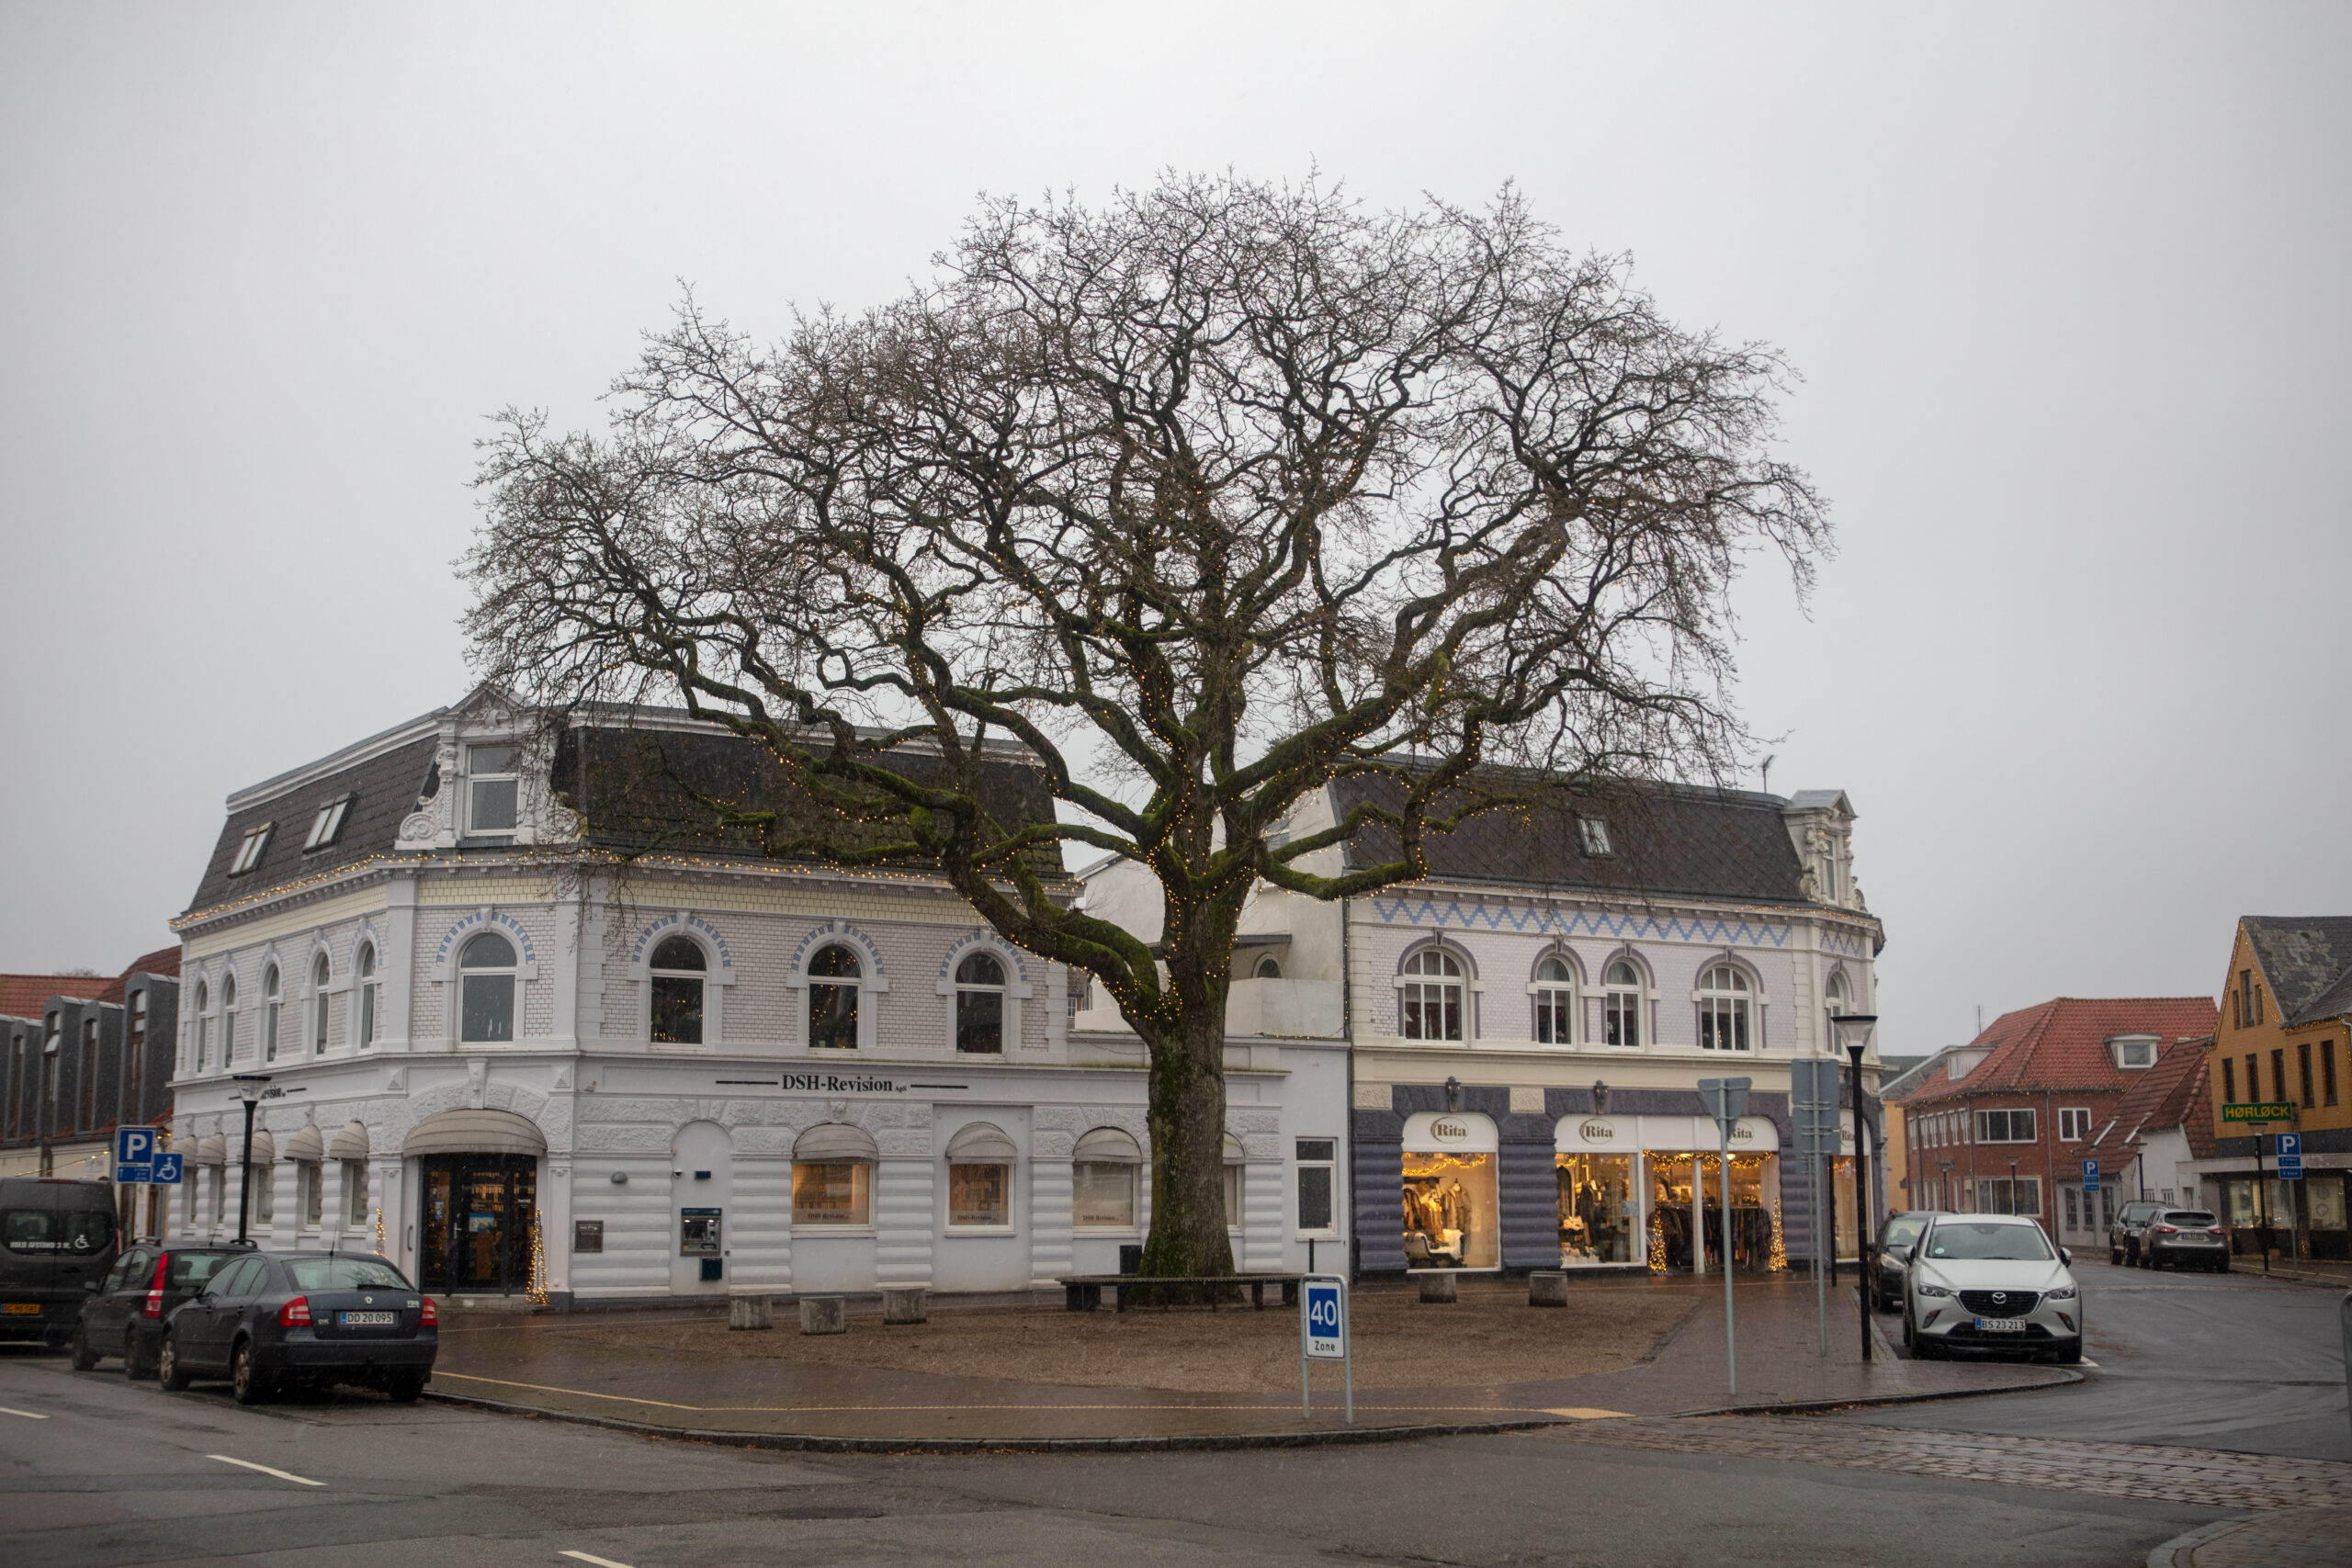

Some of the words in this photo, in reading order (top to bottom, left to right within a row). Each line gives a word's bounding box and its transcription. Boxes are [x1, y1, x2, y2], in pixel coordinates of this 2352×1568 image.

[782, 1074, 892, 1092] DSH-Revision
[2224, 1105, 2290, 1118] HØRLØCK
[1437, 1123, 1467, 1137] Rita
[1585, 1125, 1613, 1138] Rita
[127, 1134, 147, 1160] P
[2282, 1135, 2296, 1154] P
[2086, 1162, 2096, 1175] P
[347, 1314, 360, 1323] DD
[362, 1314, 374, 1323] 20
[375, 1314, 392, 1323] 095
[1310, 1300, 1337, 1326] 40
[1982, 1320, 1994, 1329] BS
[1996, 1320, 2007, 1329] 23
[2008, 1320, 2024, 1329] 213
[1315, 1341, 1336, 1351] Zone
